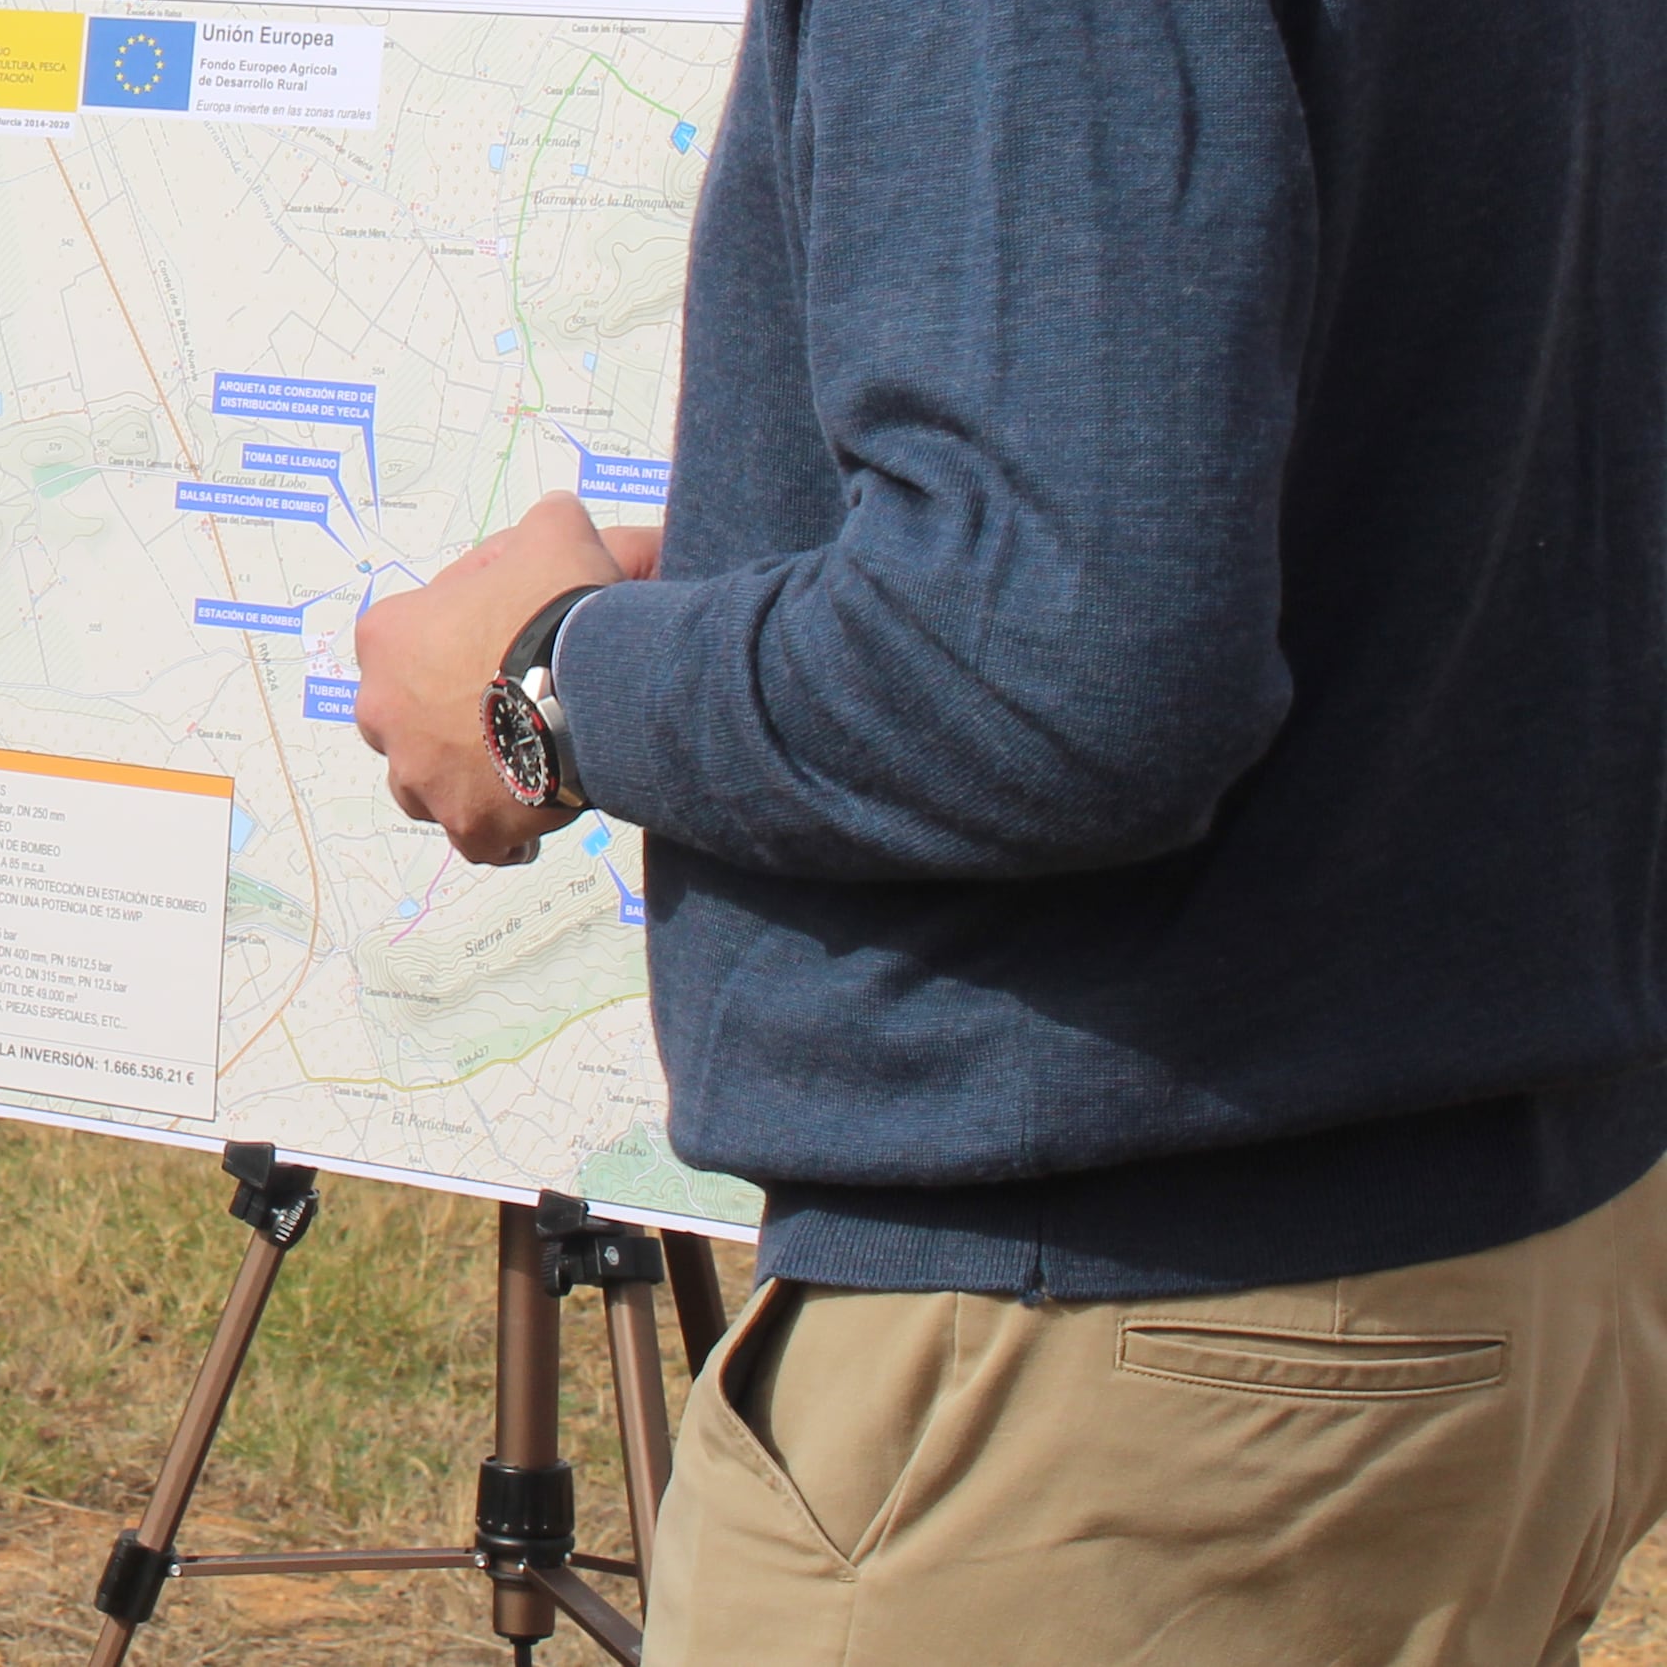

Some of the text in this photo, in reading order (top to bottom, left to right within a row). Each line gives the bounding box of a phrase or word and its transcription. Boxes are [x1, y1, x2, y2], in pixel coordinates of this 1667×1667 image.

[202, 24, 335, 50] Unión Europea
[39, 62, 67, 72] PESCA
[200, 58, 338, 79] Fondo Europeo Agrícola
[198, 75, 308, 91] de Desarrollo Rural
[196, 100, 372, 121] Europa invierte en las zonas rurales
[24, 118, 70, 129] 2014-2020
[509, 131, 581, 149] Los Arenales
[533, 190, 685, 213] Barranco de la Bronquina
[219, 380, 375, 403] ARQUETA DE CONEXIÓN RED DE
[221, 397, 370, 420] DISTRIBUCIÓN EDAR DE YECLA
[244, 450, 337, 470] TOMA DE LLENADO
[595, 461, 639, 479] TUBERÍA
[212, 470, 307, 489] Cerricos del Lobo
[581, 479, 617, 493] RAMAL
[179, 490, 324, 513] BALSA ESTACIÓN DE BOMBEO
[198, 606, 301, 628] ESTACIÓN DE BOMBEO
[309, 683, 352, 699] TUBERÍA
[317, 701, 340, 714] CON
[465, 874, 596, 959] Sierra de la Teja
[20, 1045, 98, 1070] INVERSIÓN:
[102, 1059, 182, 1084] 1.666.536,21
[186, 1071, 195, 1085] €
[391, 1110, 472, 1135] El Portichuelo
[596, 1138, 614, 1153] del
[618, 1142, 647, 1157] Lobo
